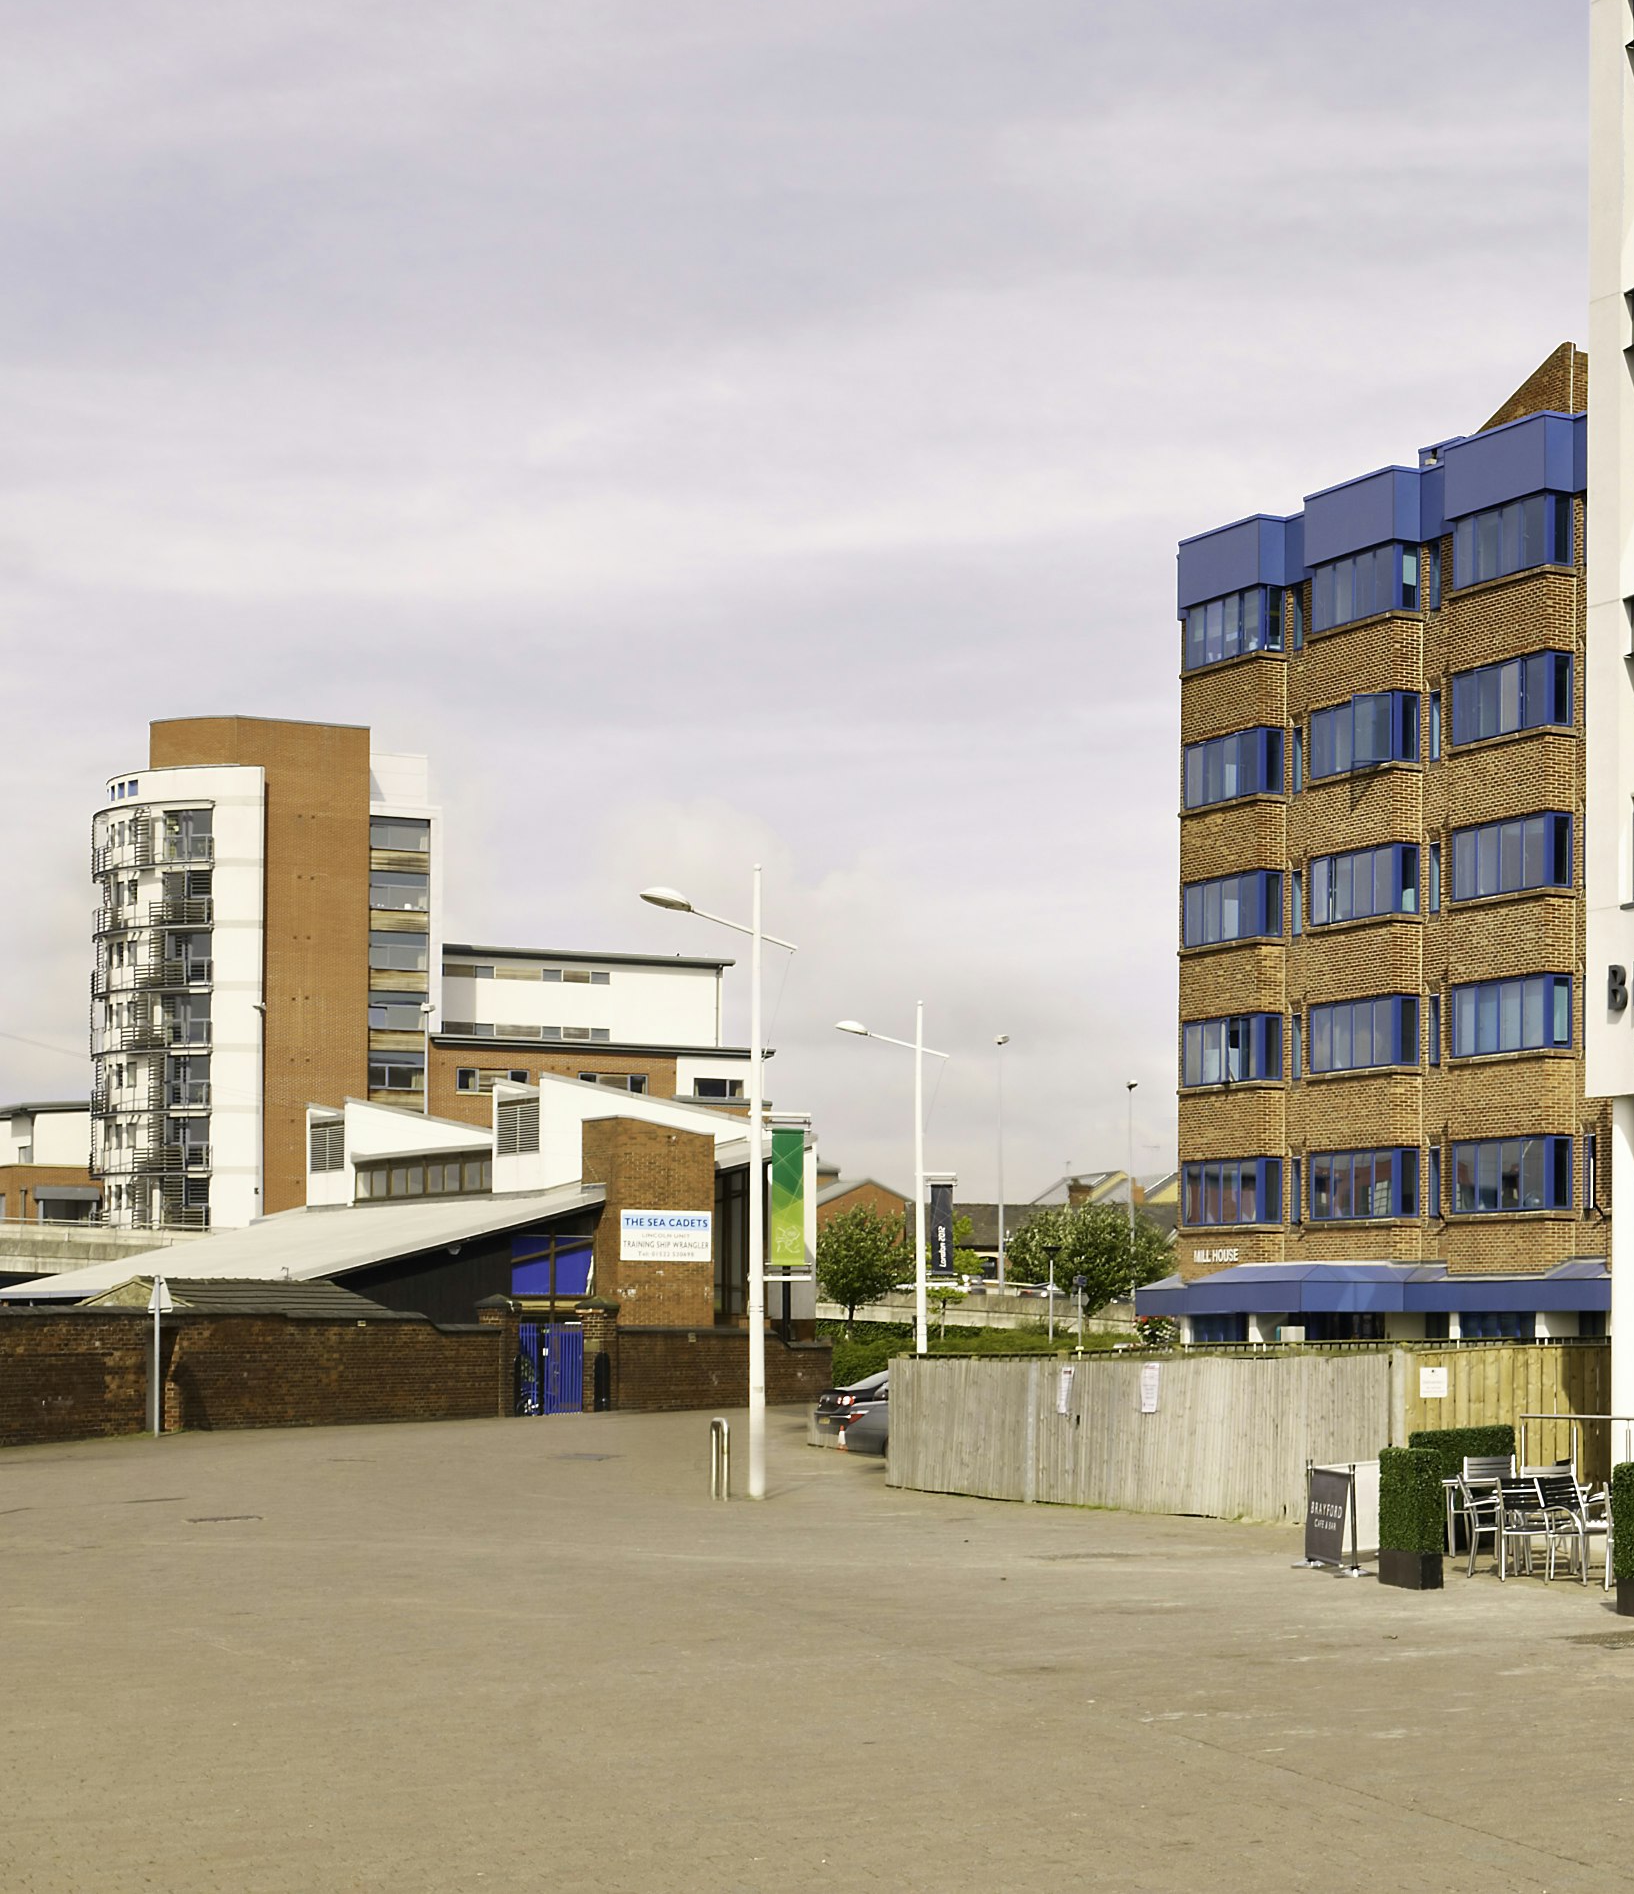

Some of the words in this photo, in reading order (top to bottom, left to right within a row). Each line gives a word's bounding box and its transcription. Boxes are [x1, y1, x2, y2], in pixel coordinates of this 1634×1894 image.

[625, 1217, 644, 1226] THE
[647, 1218, 666, 1227] SEA
[668, 1218, 708, 1228] CADETS
[938, 1225, 946, 1242] 2012
[623, 1240, 654, 1248] TRAINING
[673, 1241, 709, 1249] WRANGLER
[939, 1242, 947, 1268] London
[1193, 1249, 1211, 1262] MILL
[1212, 1248, 1239, 1262] HOUSE
[1310, 1500, 1343, 1519] BRAYFORD
[1314, 1518, 1325, 1529] CAFE
